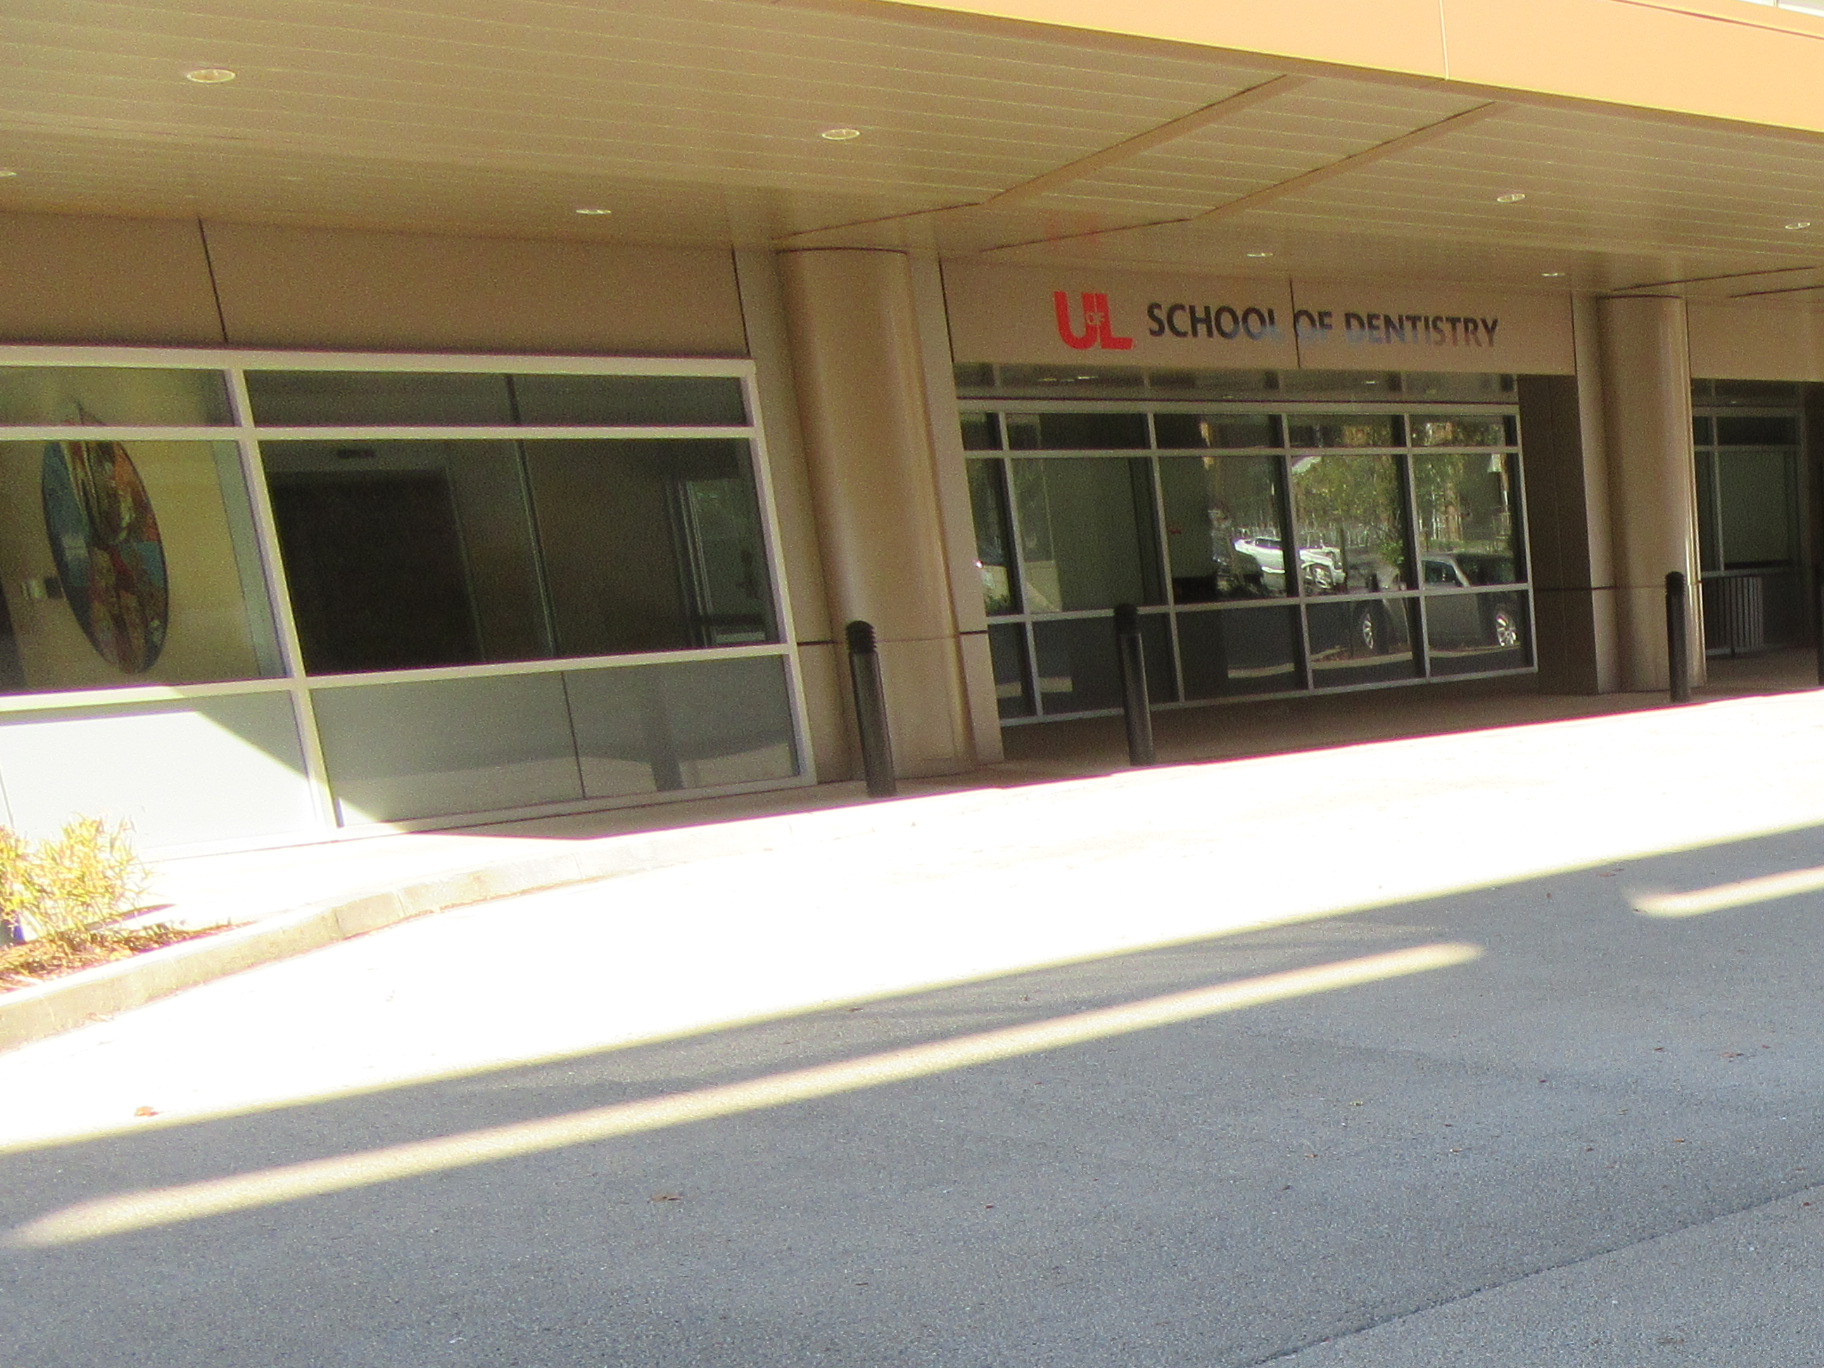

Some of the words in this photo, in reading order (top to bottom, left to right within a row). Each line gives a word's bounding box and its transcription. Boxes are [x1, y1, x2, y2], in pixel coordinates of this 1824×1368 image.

[1147, 302, 1282, 342] SCHOOL
[1295, 309, 1333, 340] OF
[1344, 312, 1499, 347] DENTISTRY
